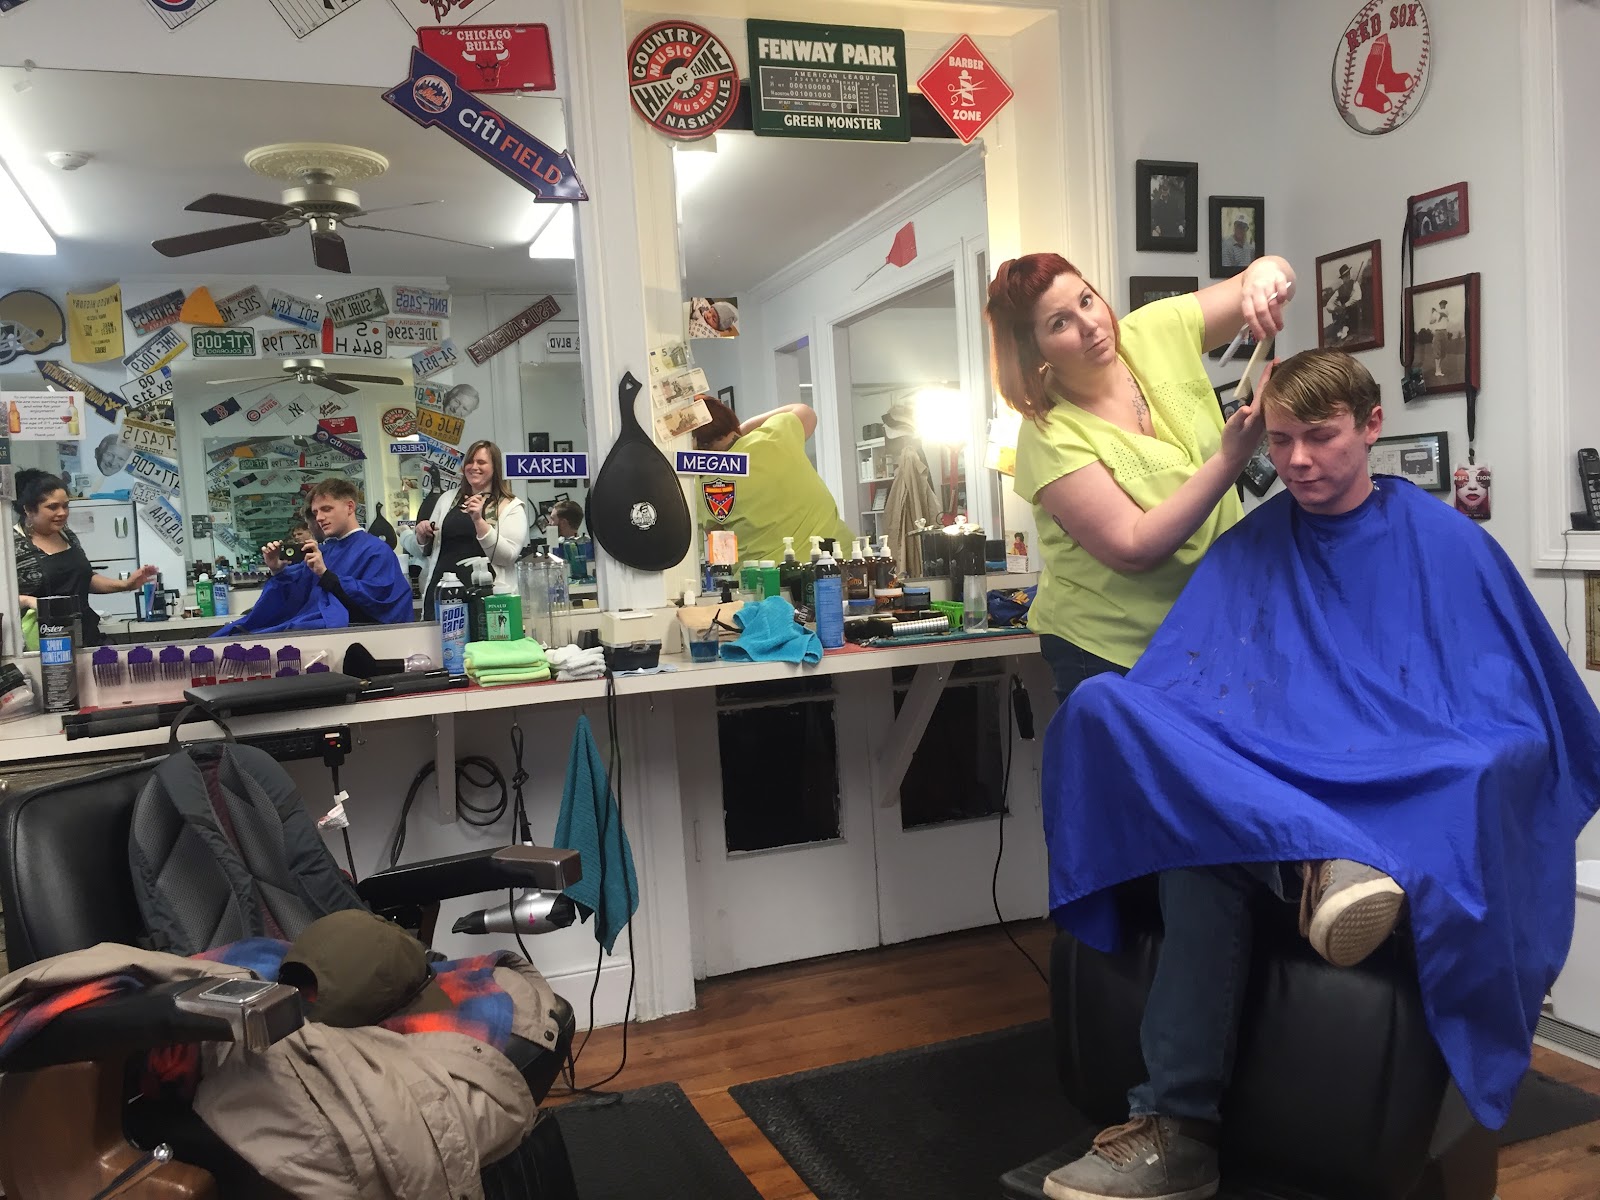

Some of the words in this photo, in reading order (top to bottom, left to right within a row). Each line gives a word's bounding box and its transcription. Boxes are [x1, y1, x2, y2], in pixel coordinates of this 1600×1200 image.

[456, 29, 511, 41] CHICAGO
[1345, 13, 1381, 52] RED
[1389, 3, 1418, 29] SOX
[465, 41, 504, 51] BULLS
[633, 29, 702, 78] COUNTRY
[758, 37, 838, 63] FENWAY
[842, 43, 897, 67] PARK
[649, 45, 692, 78] MUSIC
[948, 56, 984, 70] BARBER
[635, 82, 675, 118] HALL
[676, 73, 689, 85] OF
[690, 40, 732, 77] FAME
[794, 71, 838, 79] AMERICAN
[673, 81, 715, 112] MUSEUM
[682, 83, 701, 99] AND
[666, 79, 731, 128] NASHVILLE
[784, 114, 824, 128] GREEN
[827, 116, 882, 130] MONSTER
[953, 109, 982, 121] ZONE
[499, 134, 562, 185] FIELD
[517, 457, 576, 474] KAREN
[683, 455, 741, 472] MEGAN
[442, 607, 465, 621] COOL
[40, 624, 64, 634] Oster
[46, 640, 63, 651] SPRAY
[41, 650, 71, 663] DISINFECTANT
